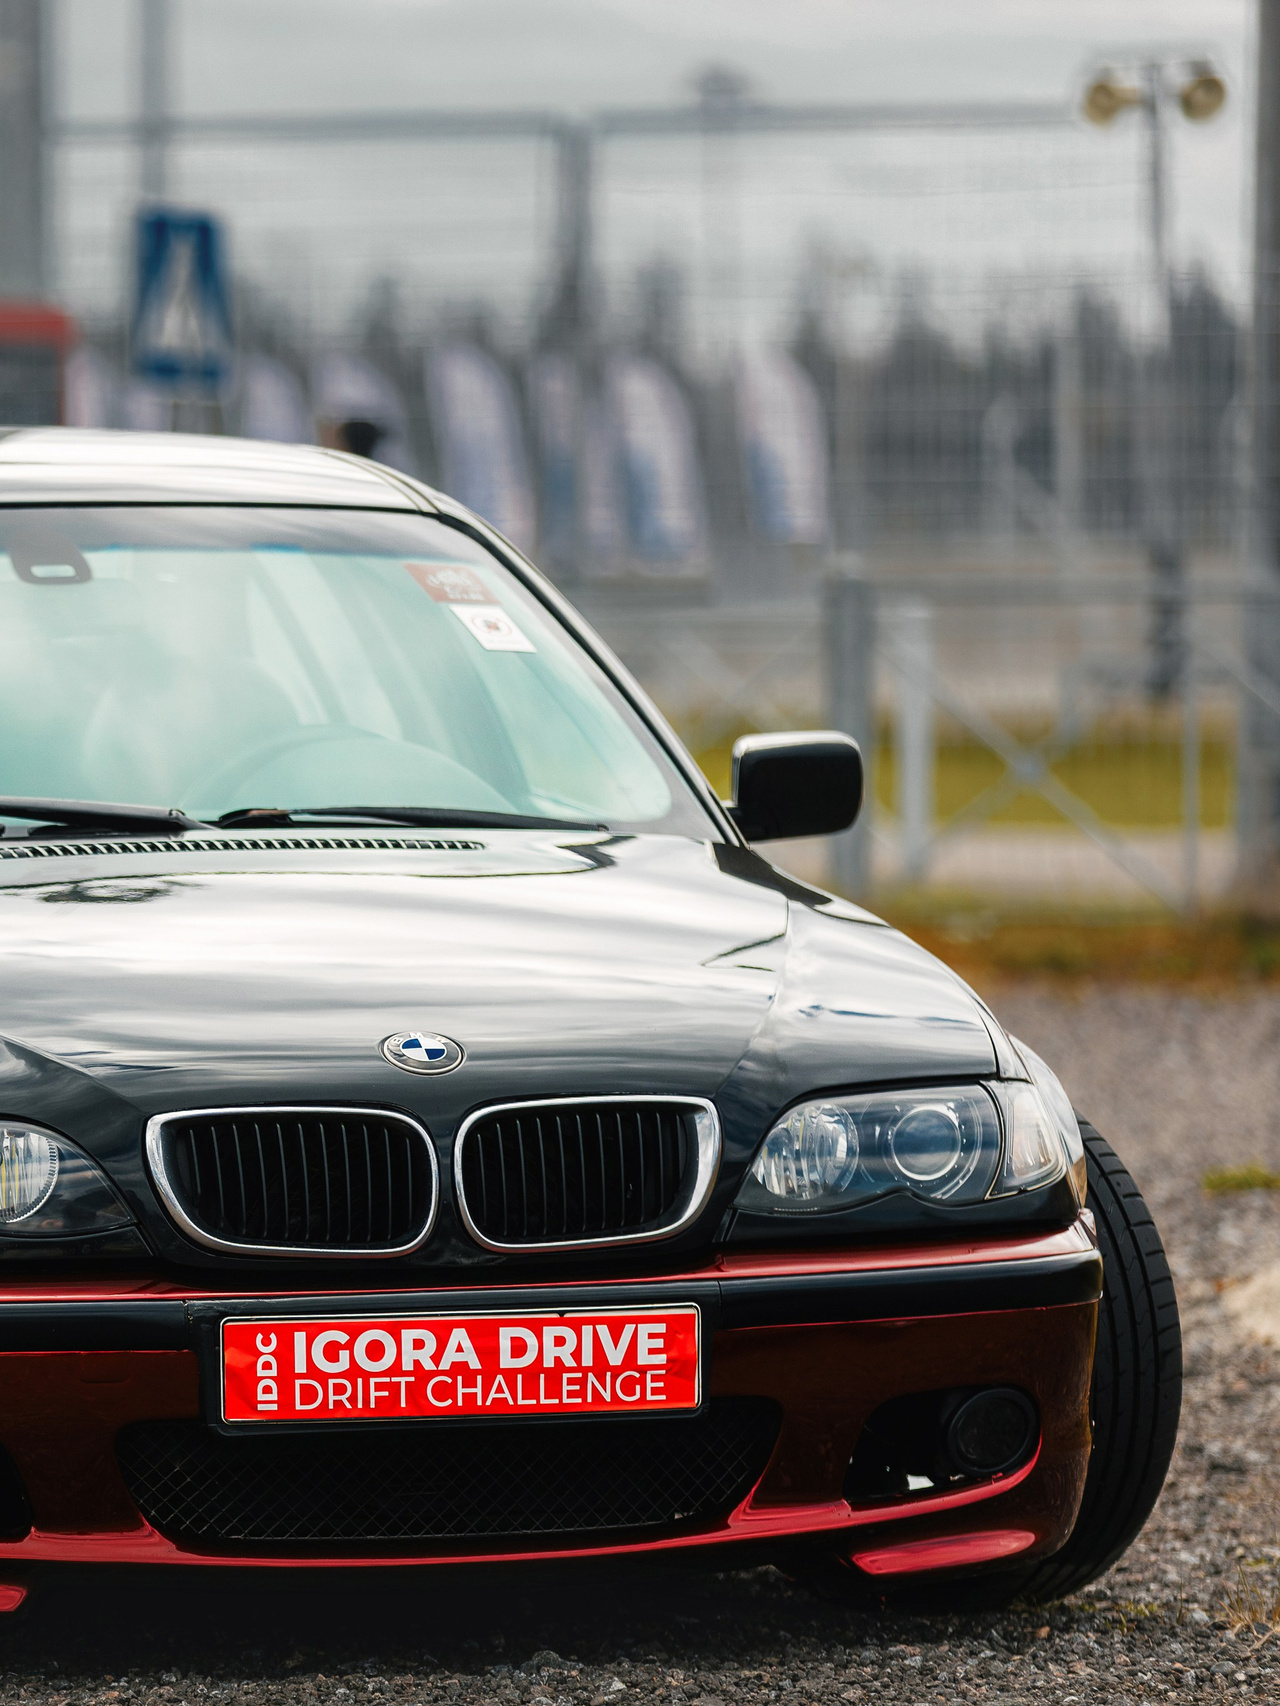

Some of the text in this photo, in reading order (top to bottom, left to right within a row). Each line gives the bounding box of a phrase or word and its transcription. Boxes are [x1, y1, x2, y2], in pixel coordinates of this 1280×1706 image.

[255, 1331, 278, 1411] IDDC
[293, 1323, 667, 1374] IGORA DRIVE
[293, 1369, 667, 1410] DRIFT CHALLENGE
